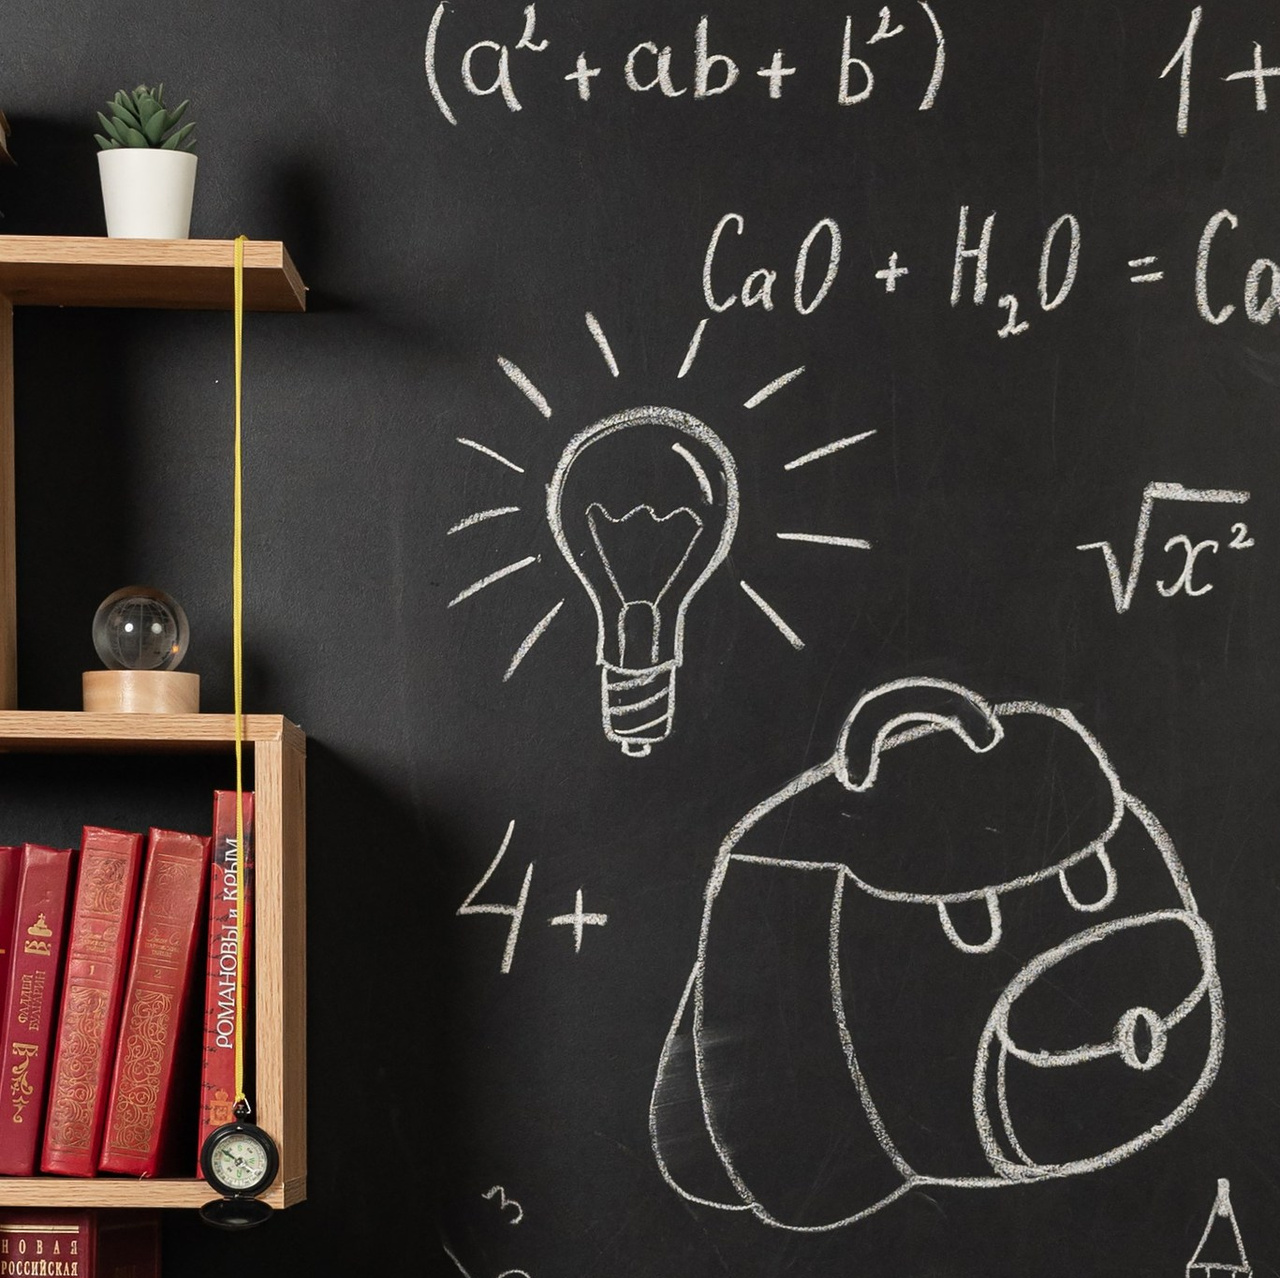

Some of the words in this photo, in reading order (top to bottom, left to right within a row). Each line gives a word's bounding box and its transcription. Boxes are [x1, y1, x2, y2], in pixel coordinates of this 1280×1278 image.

[703, 213, 841, 315] CaO
[223, 838, 238, 901] КРЫМ
[19, 972, 33, 1024] ФАДДЕЙ
[29, 971, 46, 1031] БУЛГАРИН
[215, 925, 238, 1048] РОМАНОВЫ
[1, 1239, 78, 1255] НОВАЯ
[1, 1260, 78, 1277] РОССИЙСКАЯ
